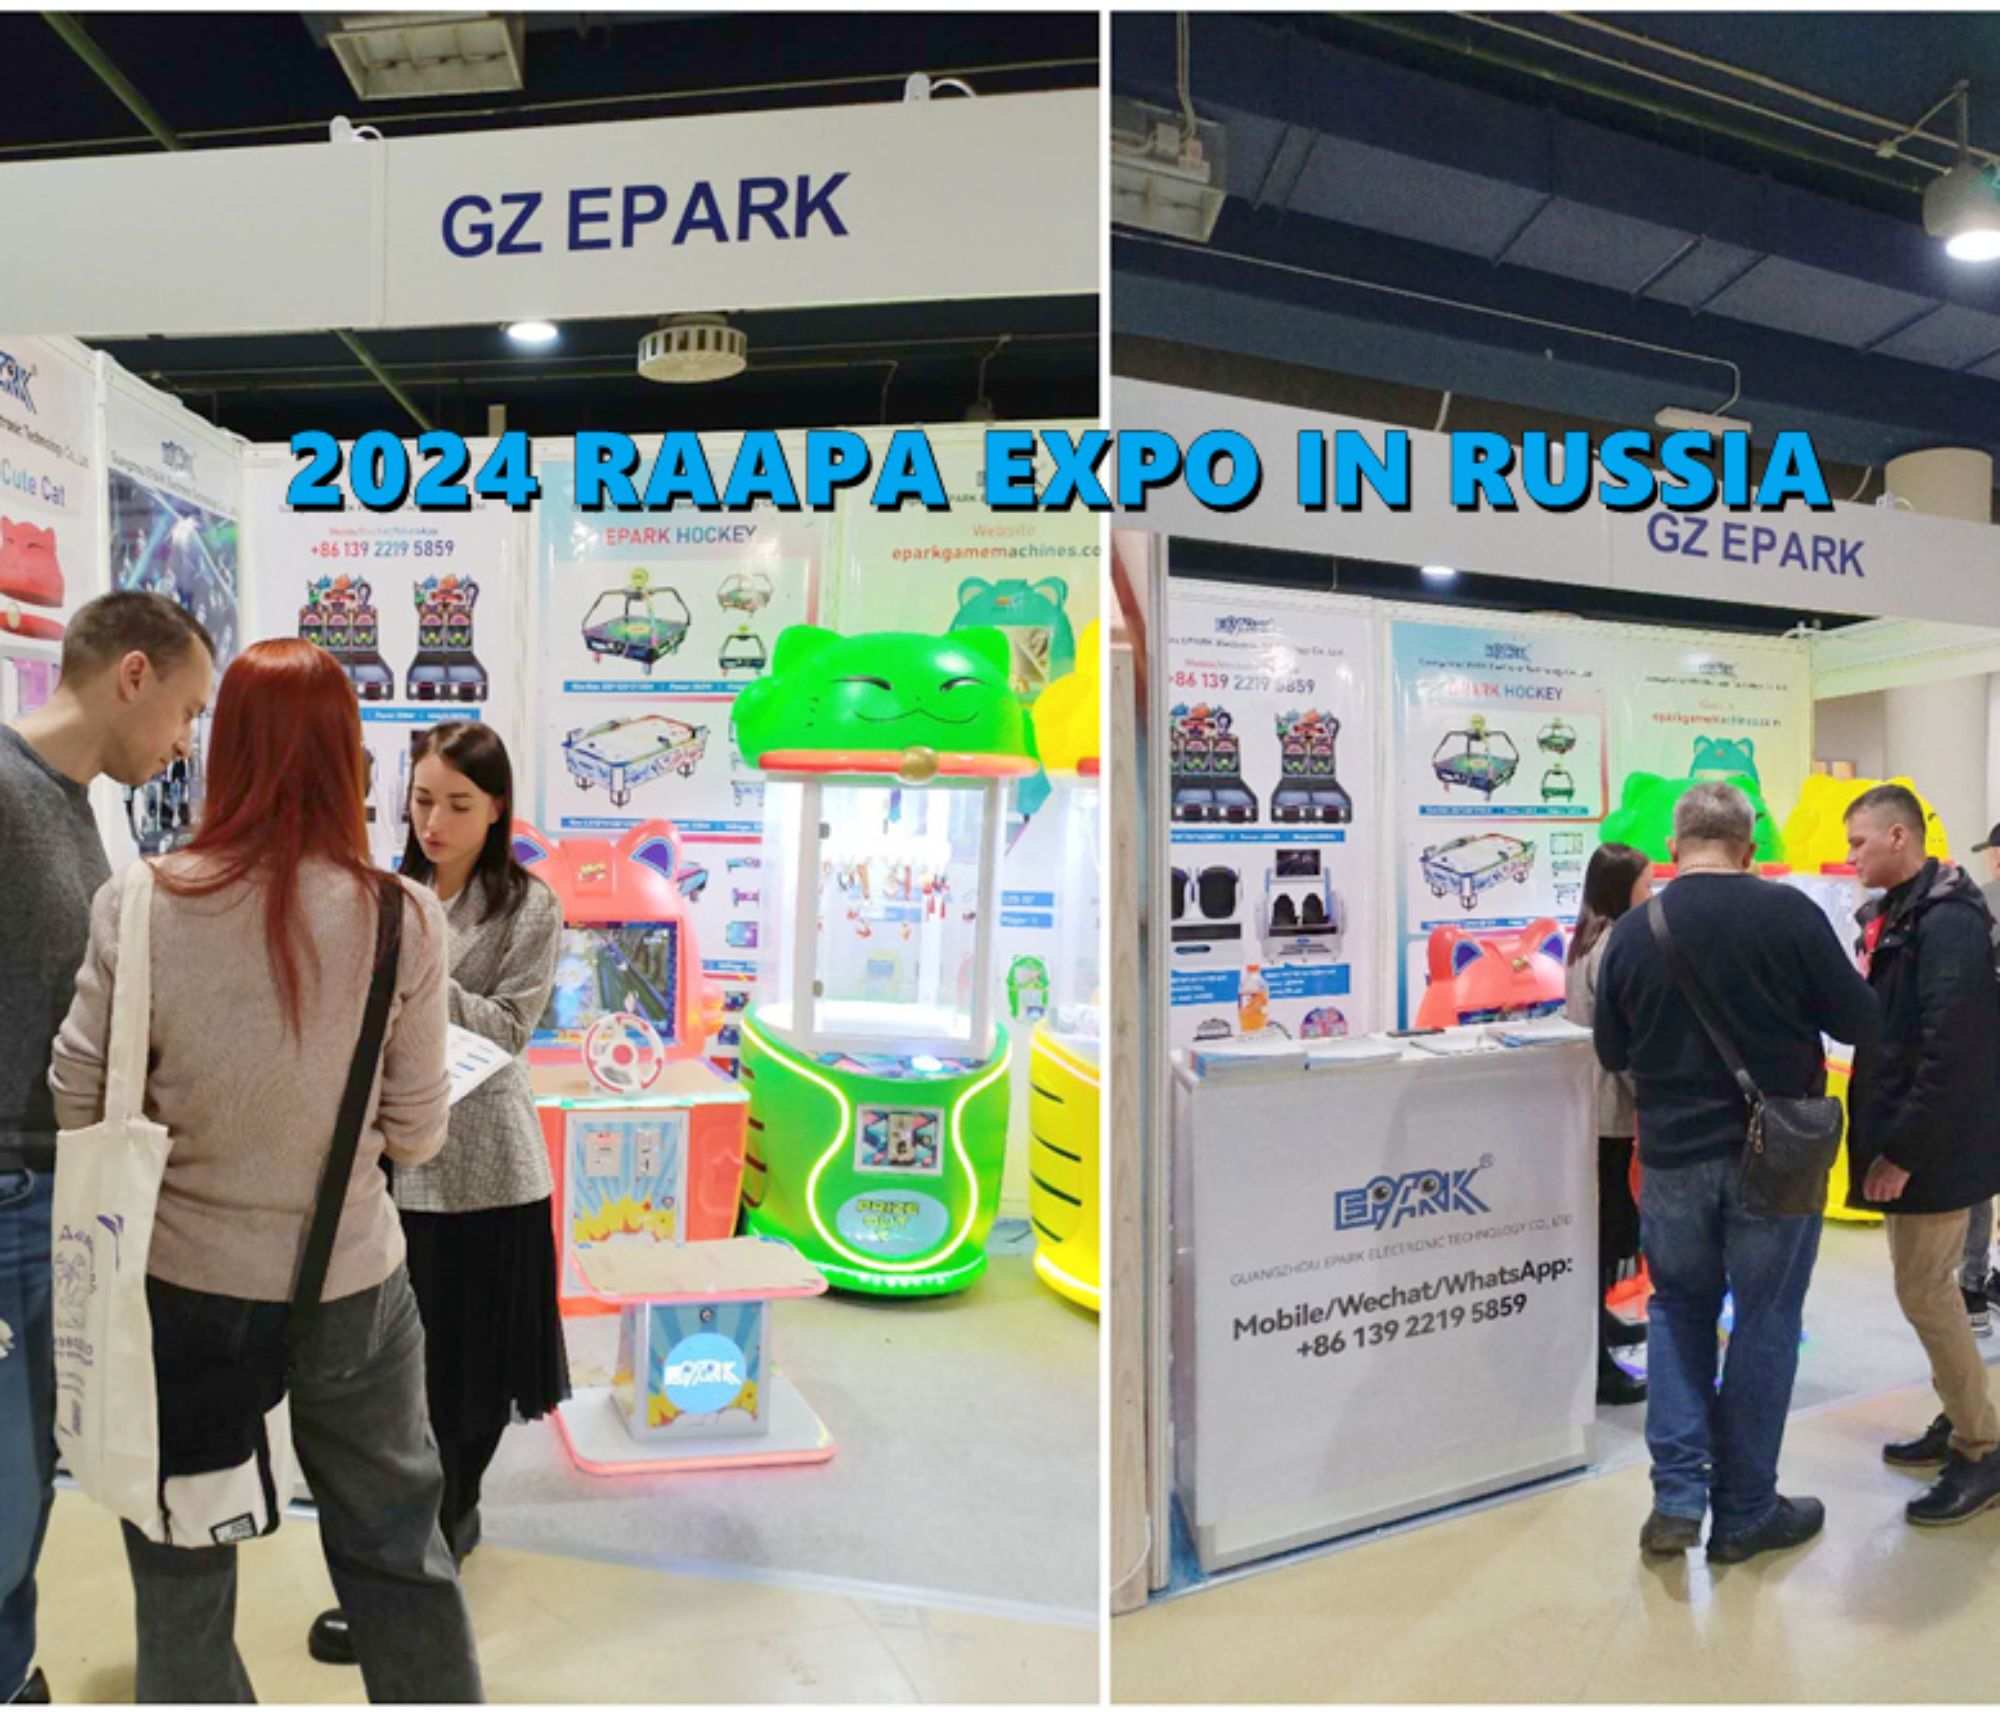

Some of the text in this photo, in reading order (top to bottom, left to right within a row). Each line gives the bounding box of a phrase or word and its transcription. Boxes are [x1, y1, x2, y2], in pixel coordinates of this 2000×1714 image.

[442, 171, 851, 258] GZ EPARK
[2, 458, 37, 497] Cute
[41, 475, 65, 508] Cat
[310, 538, 455, 558] +86 139 2219 5859
[606, 524, 758, 546] EPARK HOCKEY
[1647, 511, 1867, 578] GZ EPARK
[1202, 672, 1229, 690] 139
[1233, 674, 1271, 691] 2219
[1504, 683, 1563, 701] HOCKEY
[1229, 1259, 1321, 1288] GUANGZHOU
[1324, 1249, 1365, 1270] EPARK
[1368, 1235, 1446, 1261] ELECTRONIC
[1448, 1223, 1526, 1247] TECHNOLOGY
[1233, 1256, 1573, 1341] Mobile/Wechat/WhatsApp:
[1296, 1292, 1528, 1359] +86 139 2219 5859
